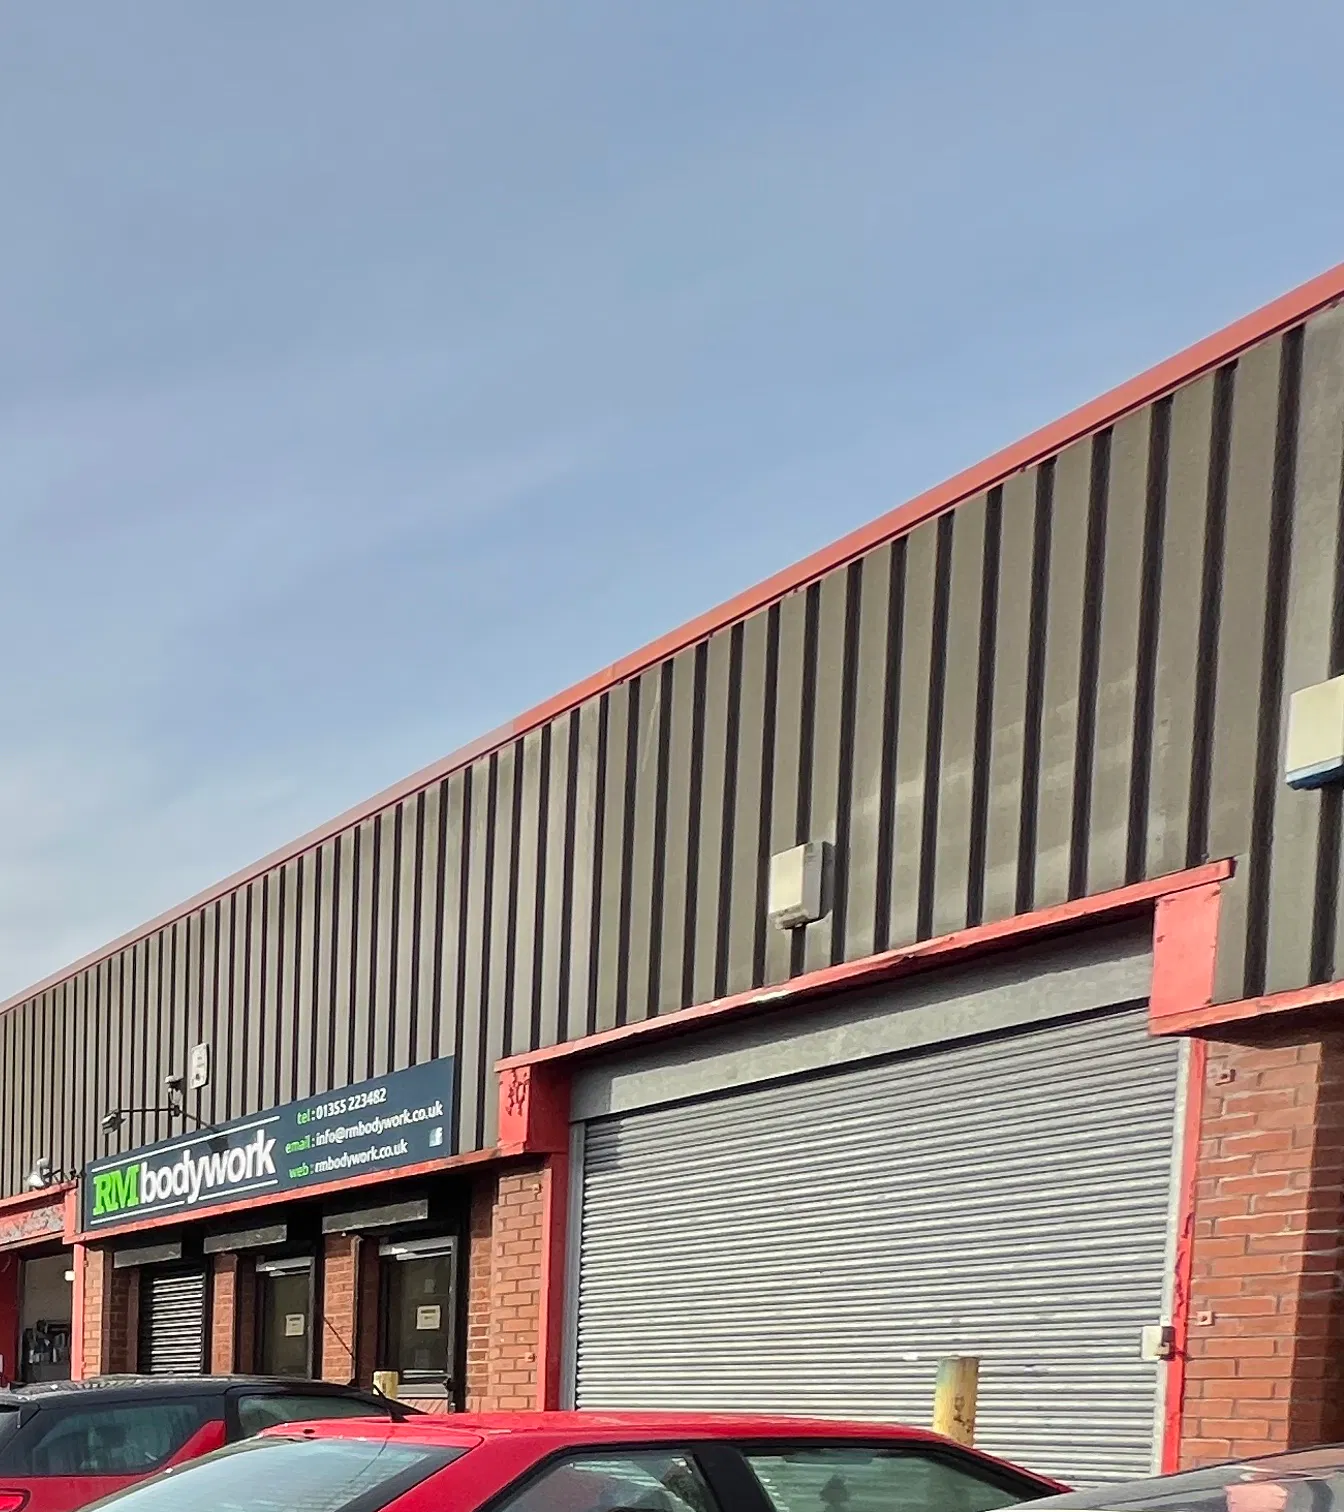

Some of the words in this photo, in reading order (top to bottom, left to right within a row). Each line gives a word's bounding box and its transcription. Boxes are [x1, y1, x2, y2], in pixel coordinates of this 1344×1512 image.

[316, 1099, 347, 1120] 01355
[348, 1087, 388, 1112] 223482
[316, 1100, 444, 1146] info@rmbodywork.co.uk
[314, 1138, 409, 1173] rmbodywork.co.uk
